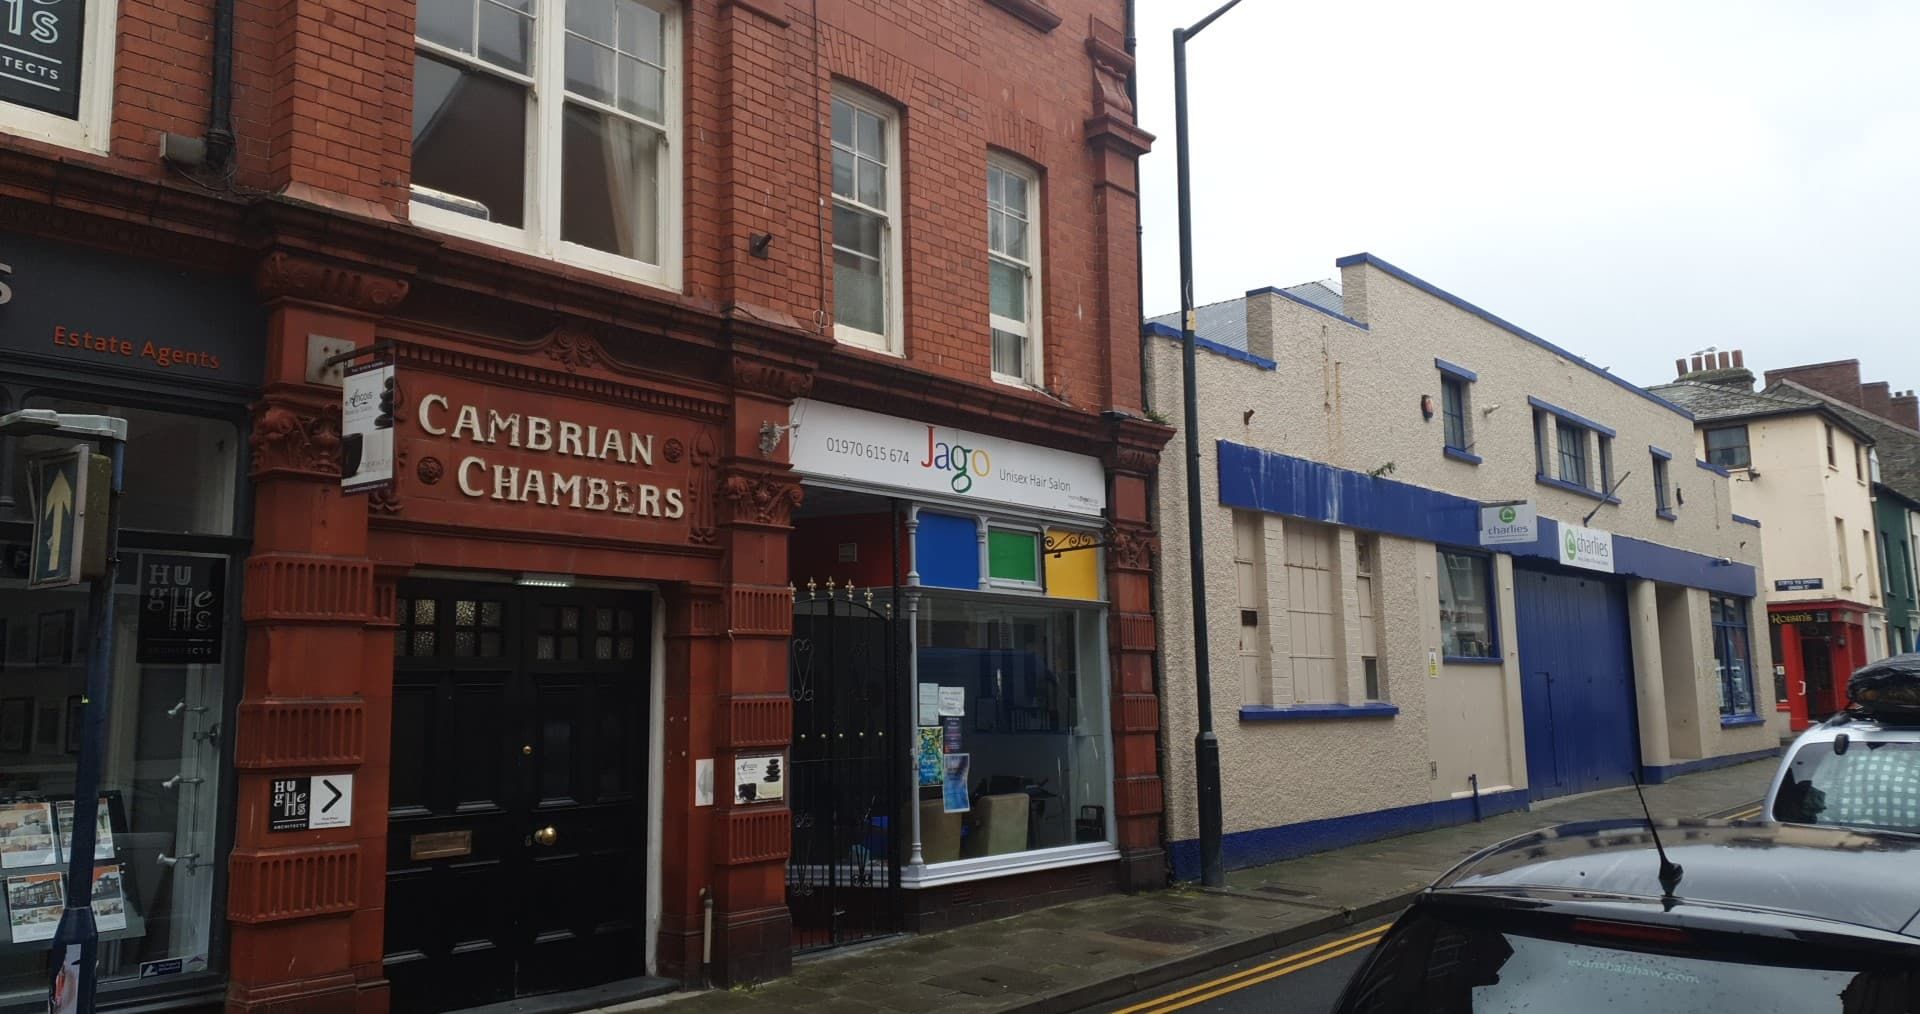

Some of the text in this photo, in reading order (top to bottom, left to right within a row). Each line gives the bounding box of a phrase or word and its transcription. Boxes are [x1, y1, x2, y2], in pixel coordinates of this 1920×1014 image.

[53, 325, 221, 369] Estate Agents
[417, 392, 655, 467] CAMBRIAN
[825, 425, 1071, 494] 01970 615 674 Jago Unisex Hair Salon
[457, 455, 686, 520] CHAMBERS
[1487, 524, 1529, 536] charlies
[1576, 533, 1609, 558] charlies
